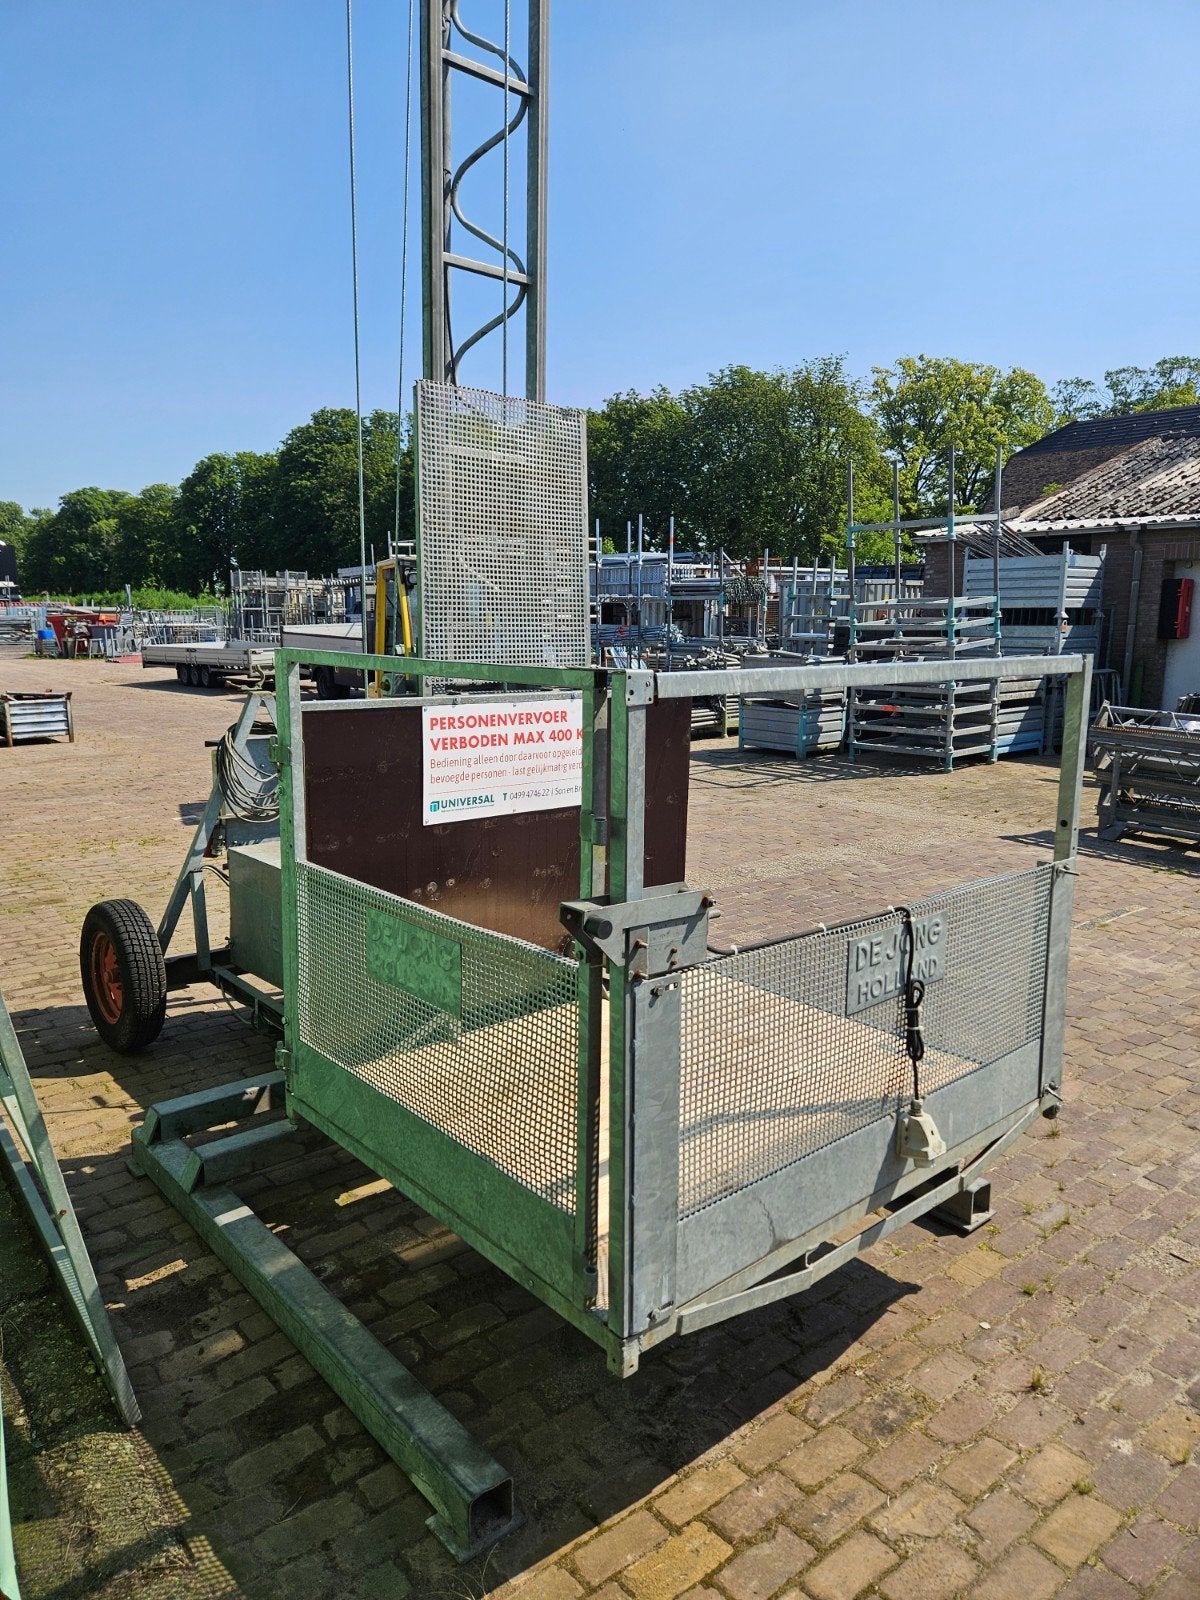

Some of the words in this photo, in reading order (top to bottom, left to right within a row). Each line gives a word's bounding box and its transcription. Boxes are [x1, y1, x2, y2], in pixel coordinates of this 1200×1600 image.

[430, 711, 568, 731] PERSONENVERVOER
[430, 733, 508, 751] VERBODEN
[513, 731, 545, 745] MAX
[549, 729, 572, 742] 400
[430, 757, 472, 769] Bediening
[474, 754, 499, 765] alleen
[499, 753, 517, 763] door
[518, 751, 551, 761] daarvoor
[430, 771, 470, 784] bevoegde
[471, 769, 507, 782] personen
[512, 766, 525, 776] last
[527, 763, 567, 777] gelijkmatig
[441, 794, 495, 809] UNIVERSAL
[503, 793, 508, 801] T
[855, 935, 883, 973] DE
[886, 918, 942, 960] JONG
